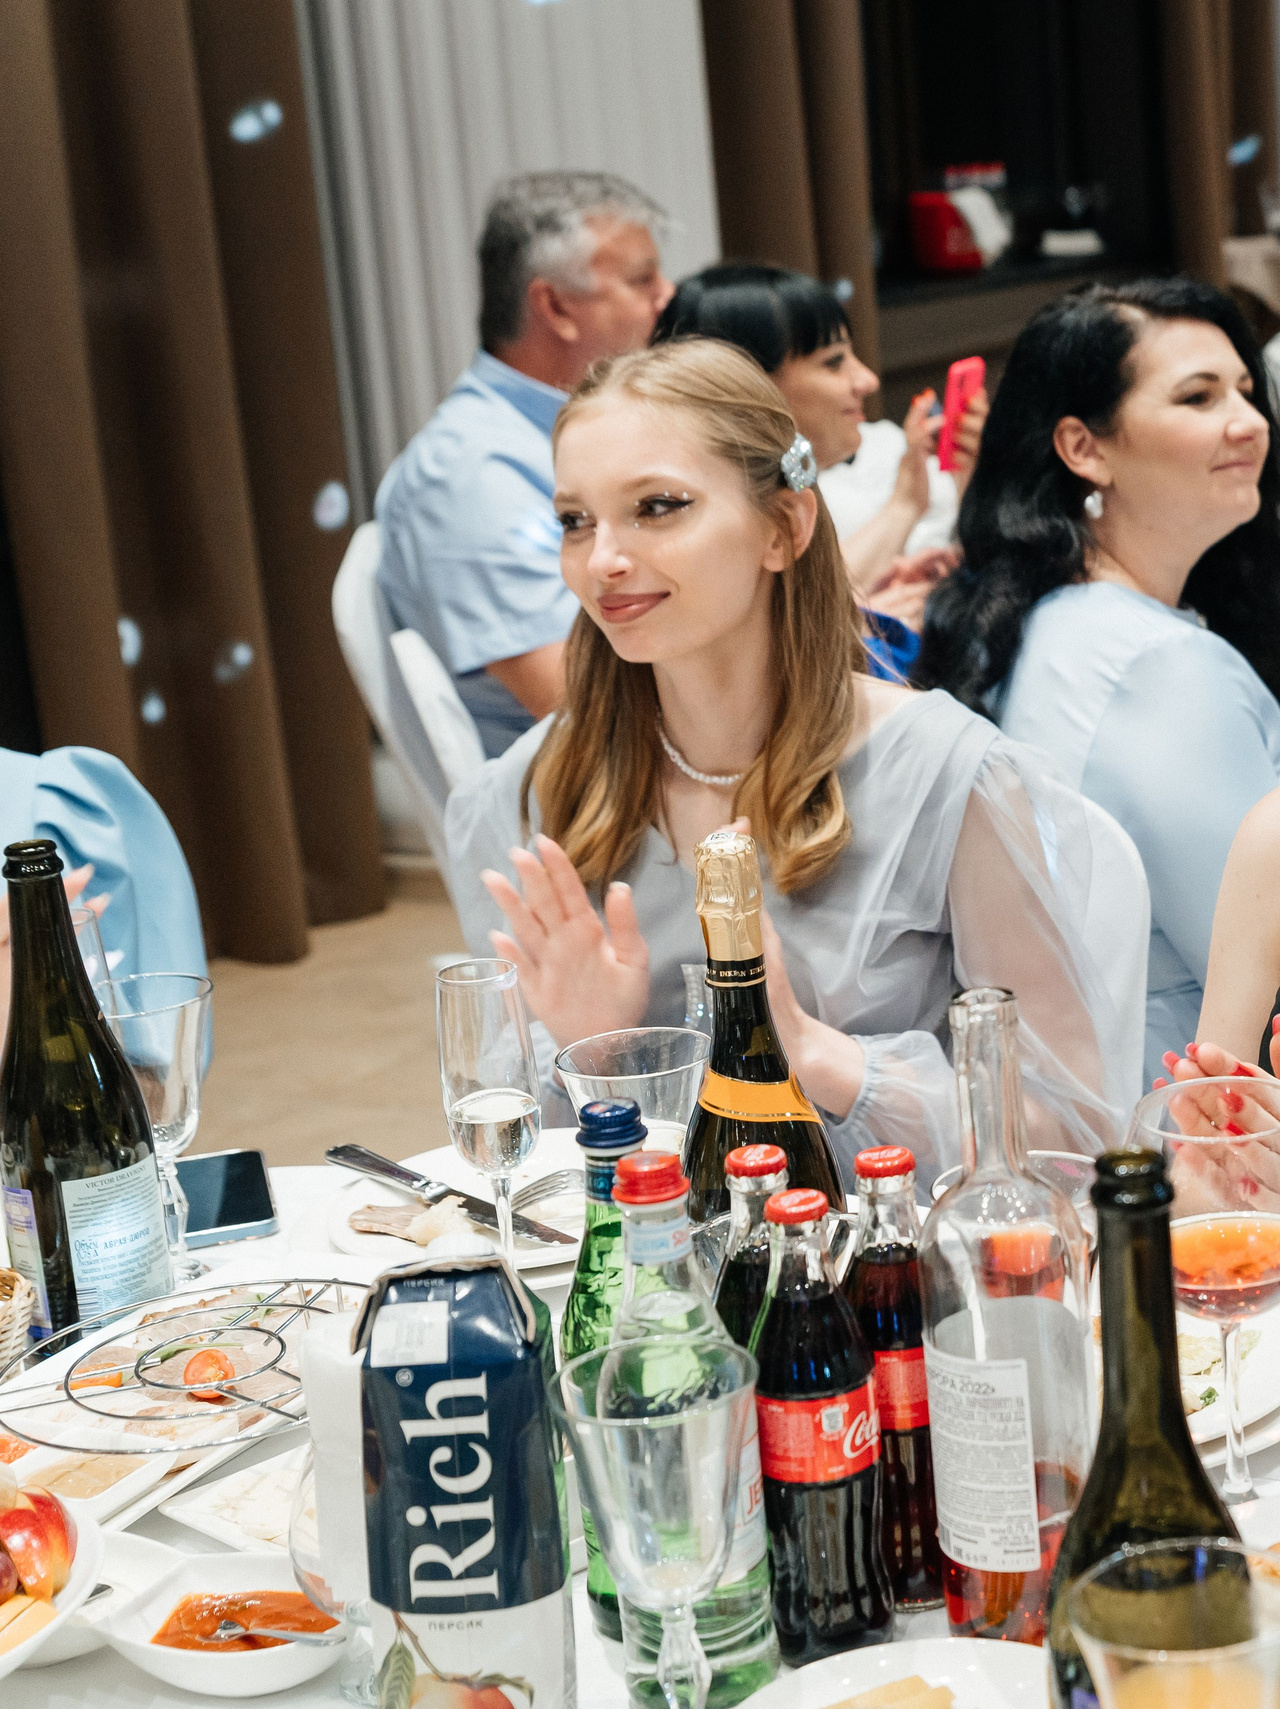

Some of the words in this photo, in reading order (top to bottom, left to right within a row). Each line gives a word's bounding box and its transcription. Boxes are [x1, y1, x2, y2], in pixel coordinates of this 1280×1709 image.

[84, 1176, 115, 1189] VICTOR
[399, 1370, 499, 1605] Rich
[428, 1618, 483, 1633] ПЕРСИК
